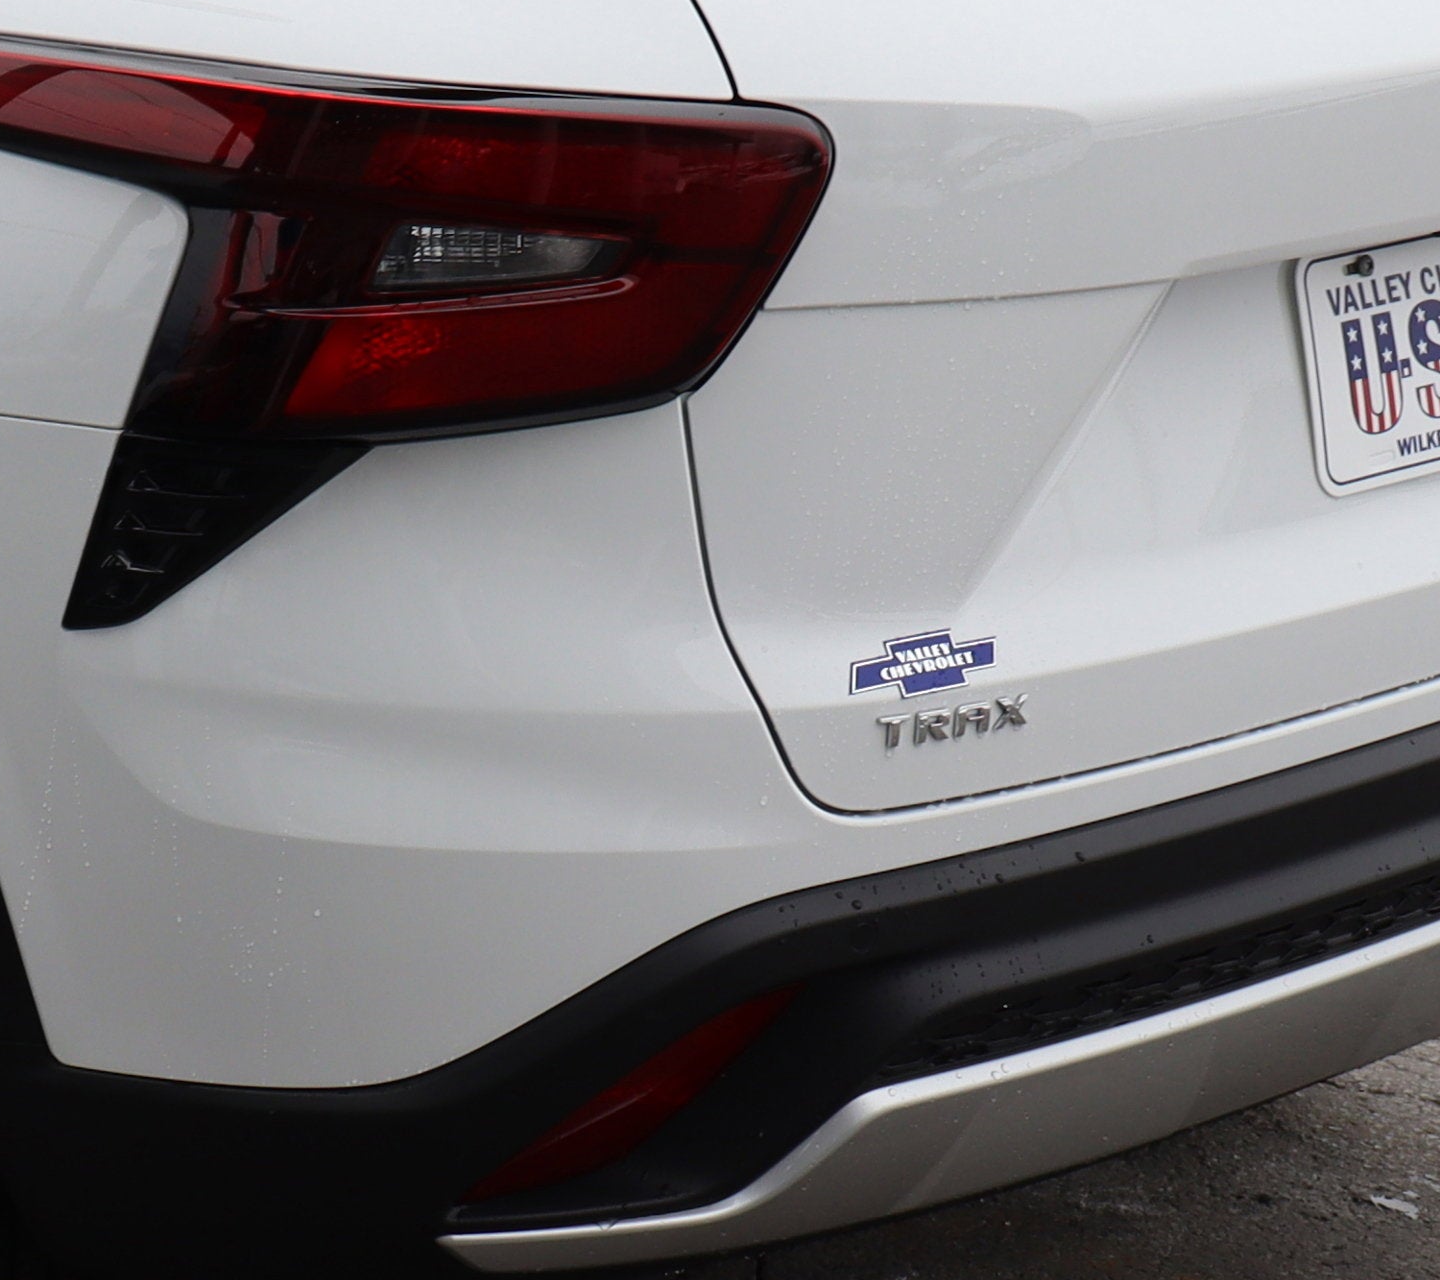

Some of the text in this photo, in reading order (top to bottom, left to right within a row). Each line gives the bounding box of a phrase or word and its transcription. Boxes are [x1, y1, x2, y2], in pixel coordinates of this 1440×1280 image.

[1326, 272, 1411, 316] VALLEY
[880, 651, 974, 680] CHEVROLET
[895, 642, 952, 663] VALLEY
[876, 693, 1029, 748] TRAX
